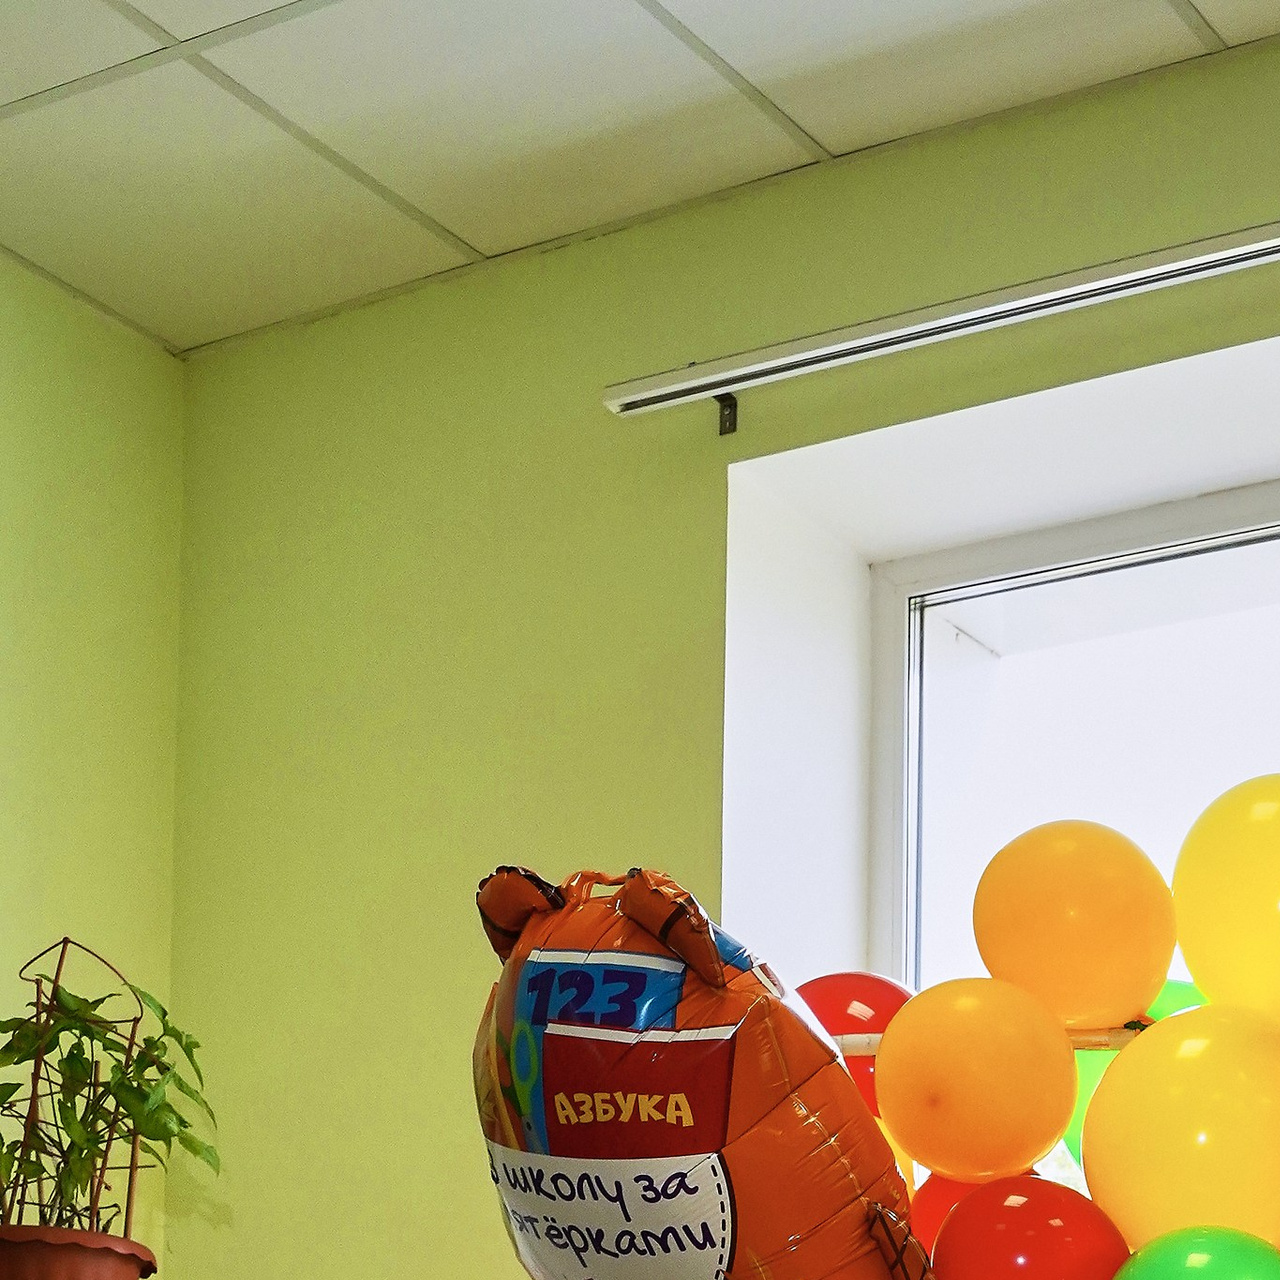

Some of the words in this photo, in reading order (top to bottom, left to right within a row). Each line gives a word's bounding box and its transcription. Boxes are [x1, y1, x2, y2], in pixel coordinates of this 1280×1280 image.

[526, 968, 647, 1027] 123
[554, 1091, 695, 1126] АЗБУКА
[503, 1163, 631, 1222] школу
[634, 1172, 699, 1203] за
[510, 1209, 717, 1268] ятёрками
